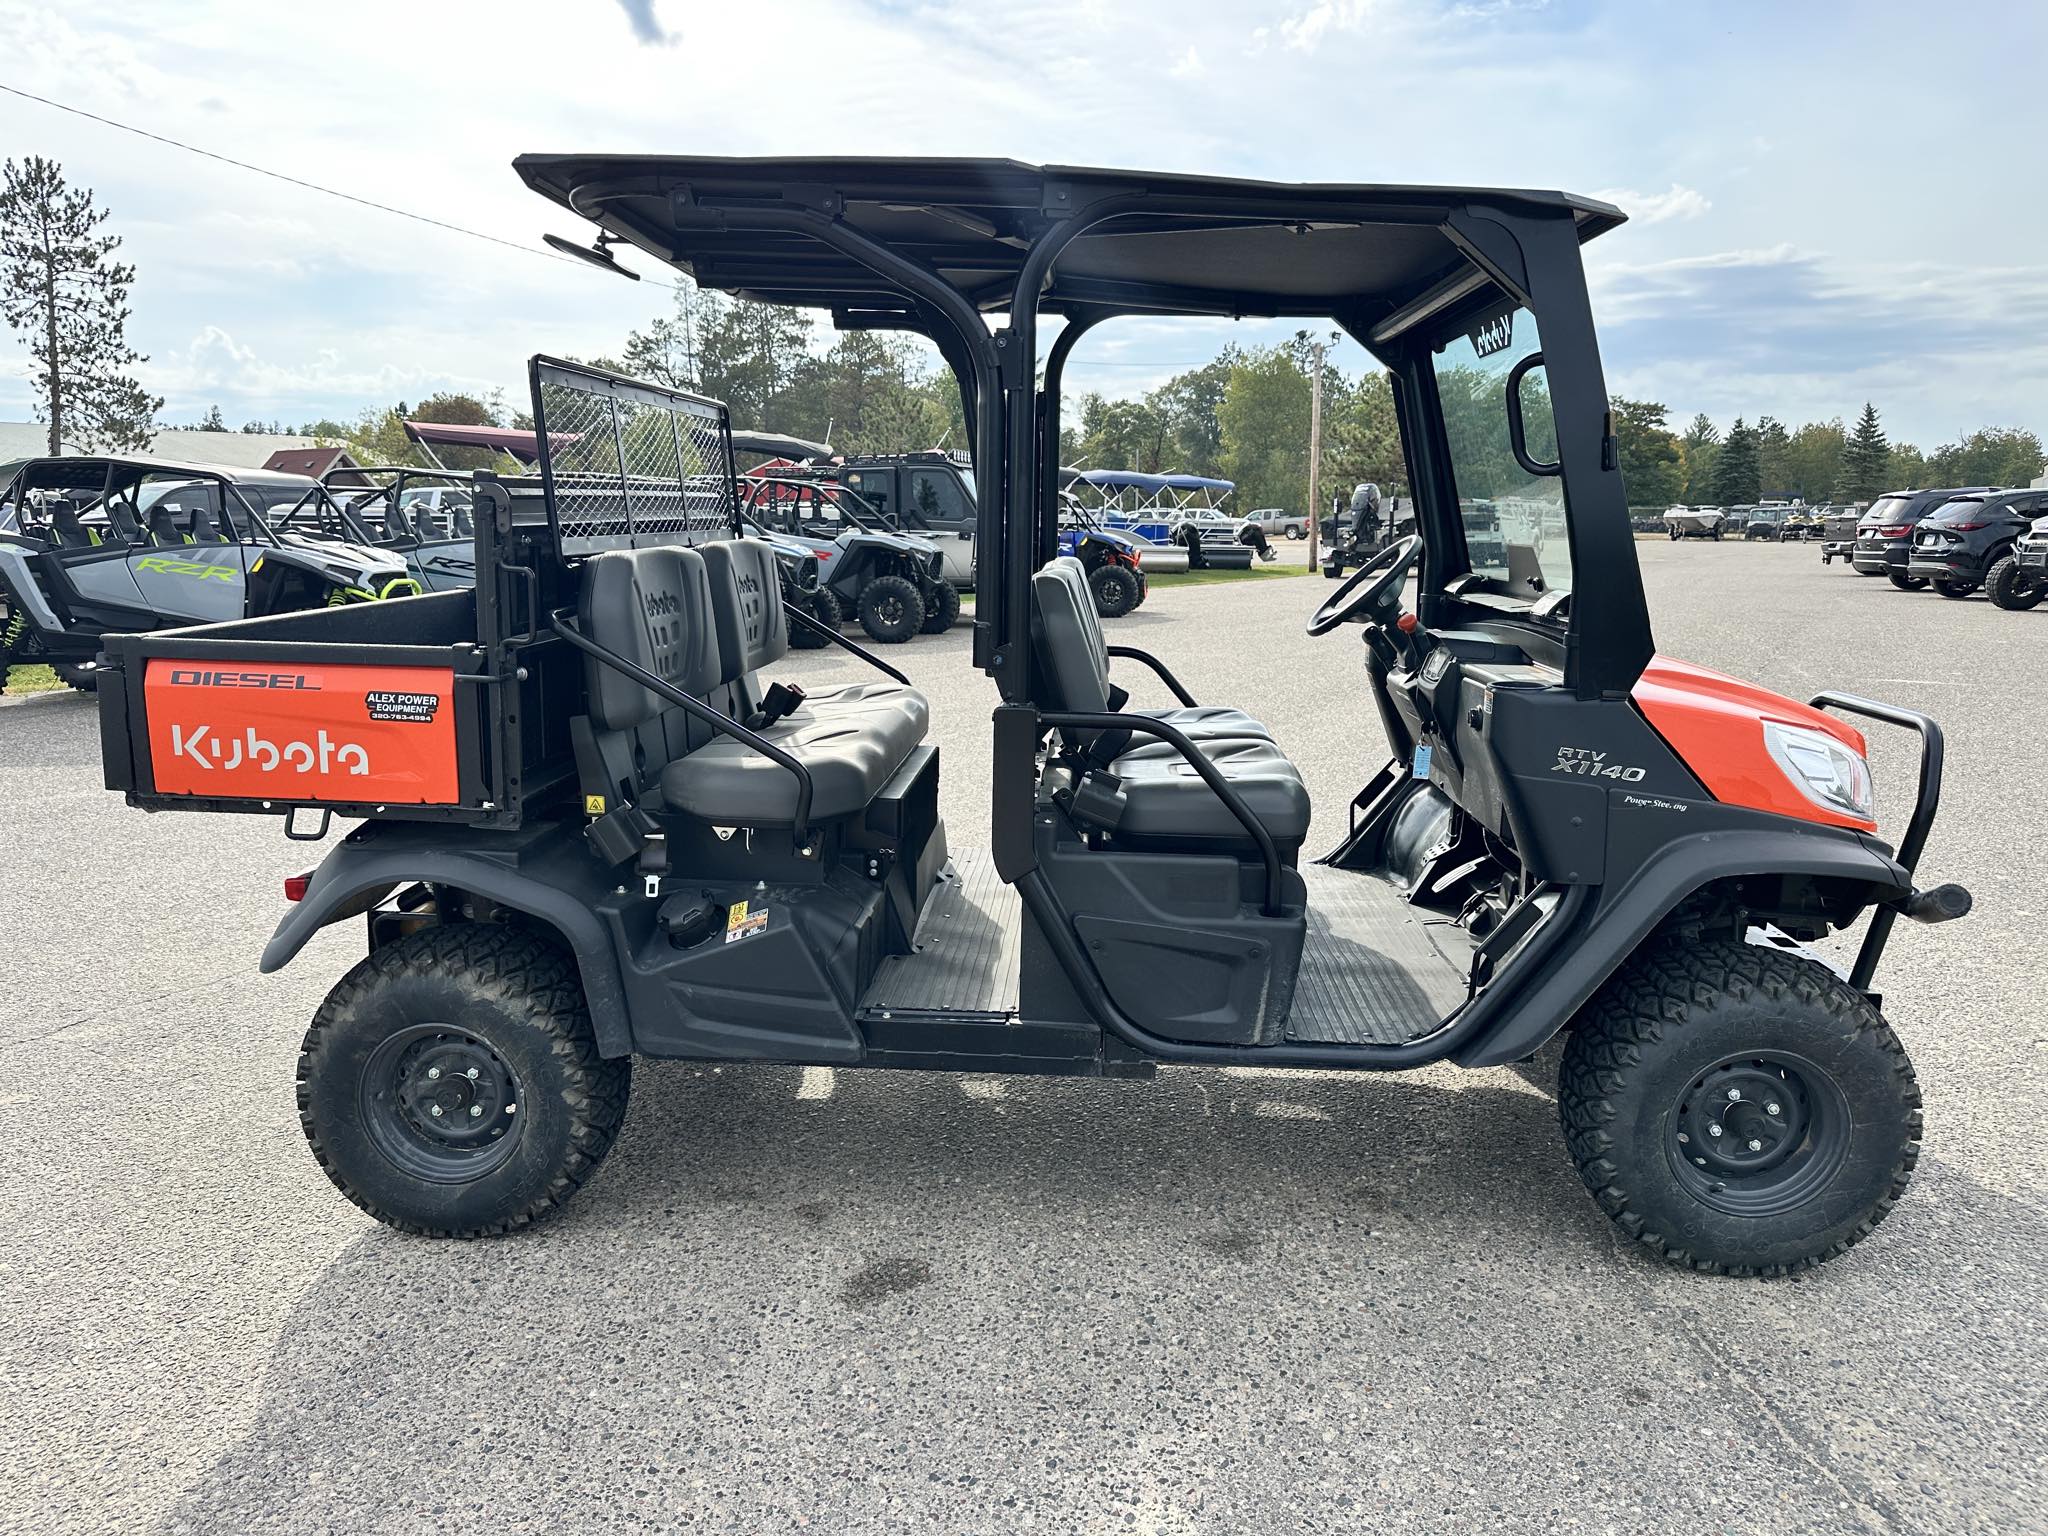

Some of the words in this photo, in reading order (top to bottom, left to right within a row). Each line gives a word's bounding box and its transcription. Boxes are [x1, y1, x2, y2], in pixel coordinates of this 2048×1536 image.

[135, 557, 239, 583] RZR
[425, 555, 476, 571] RZ
[170, 670, 322, 691] DIESEL
[367, 693, 396, 704] ALEX
[397, 694, 438, 706] POWER
[376, 703, 429, 714] EQUIPMENT
[171, 724, 370, 776] Kubota
[1557, 746, 1607, 761] RTV
[1550, 757, 1647, 782] X1140
